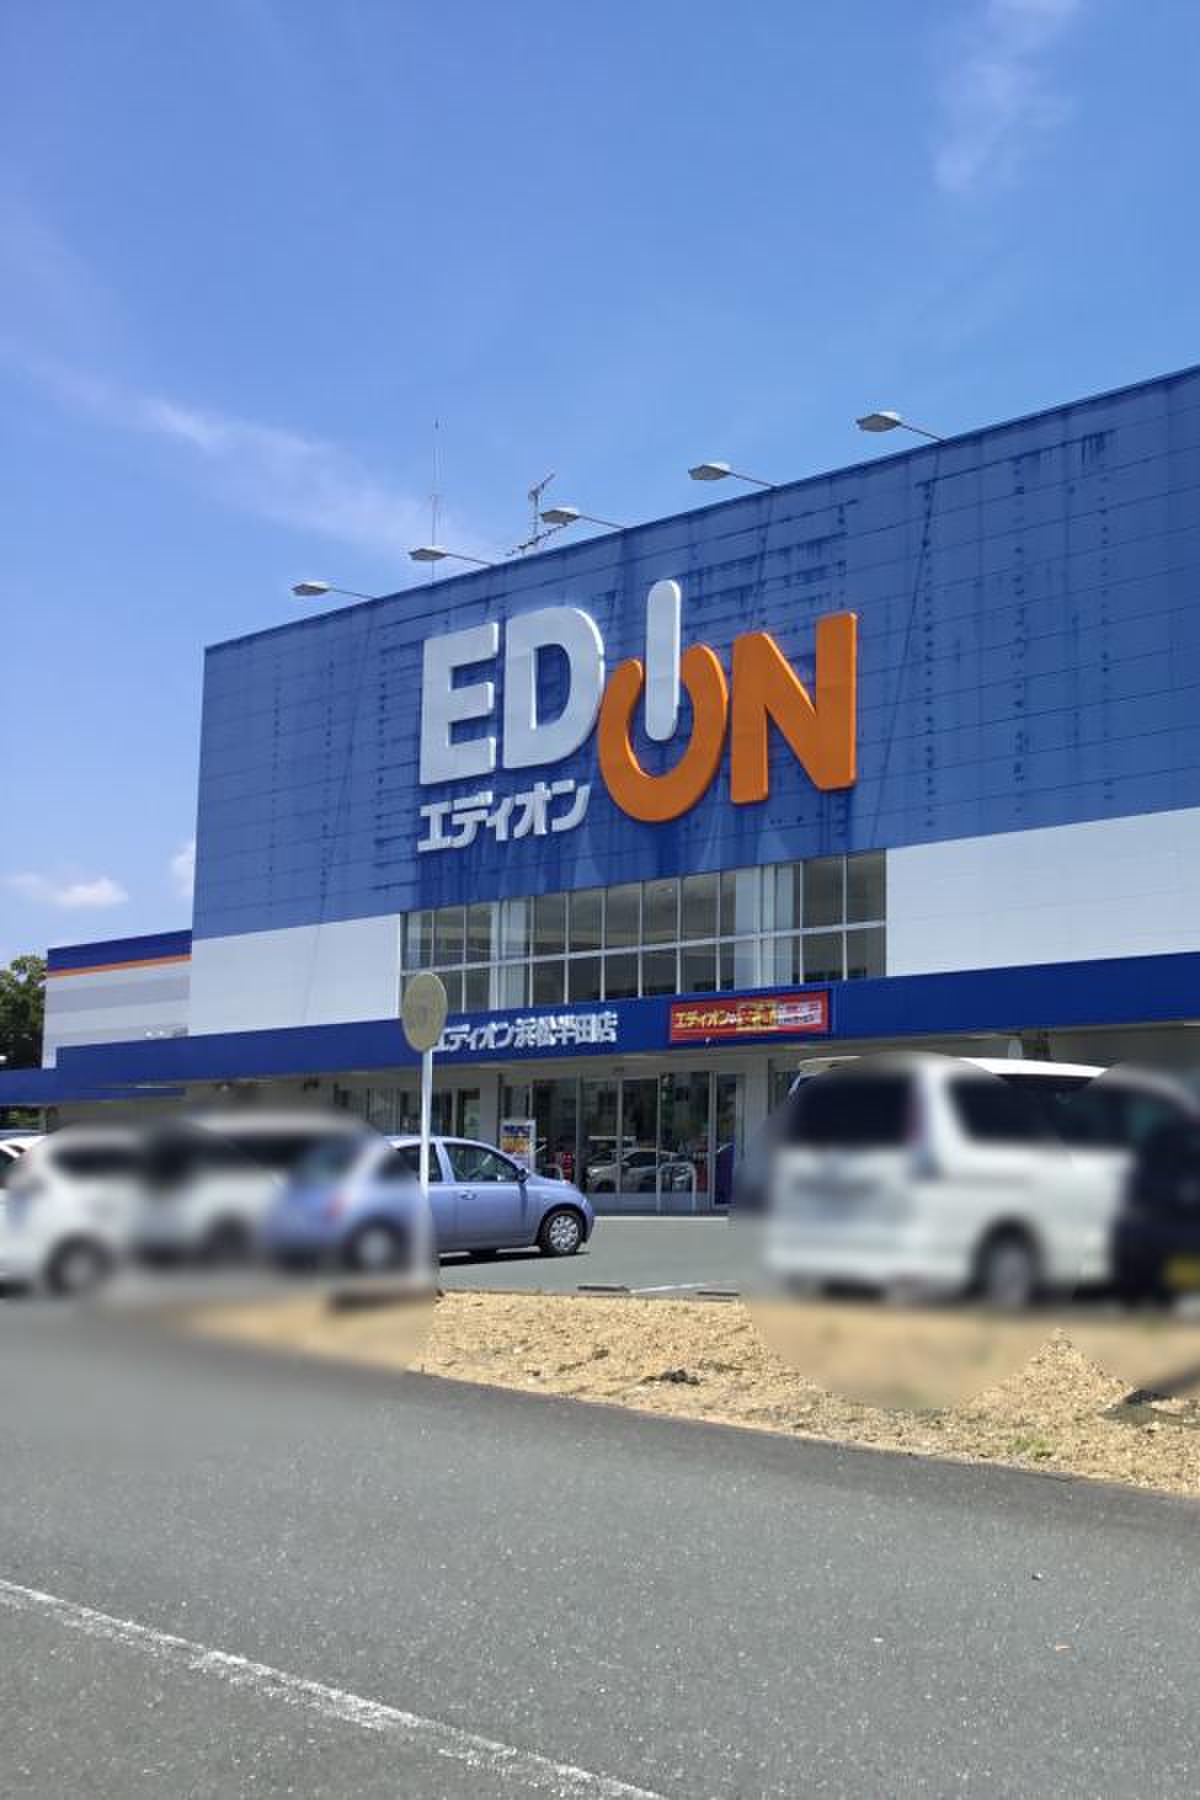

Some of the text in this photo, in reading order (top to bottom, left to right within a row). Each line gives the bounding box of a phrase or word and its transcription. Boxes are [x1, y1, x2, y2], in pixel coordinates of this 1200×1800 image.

[418, 579, 859, 822] EDION
[417, 779, 591, 853] エディオン
